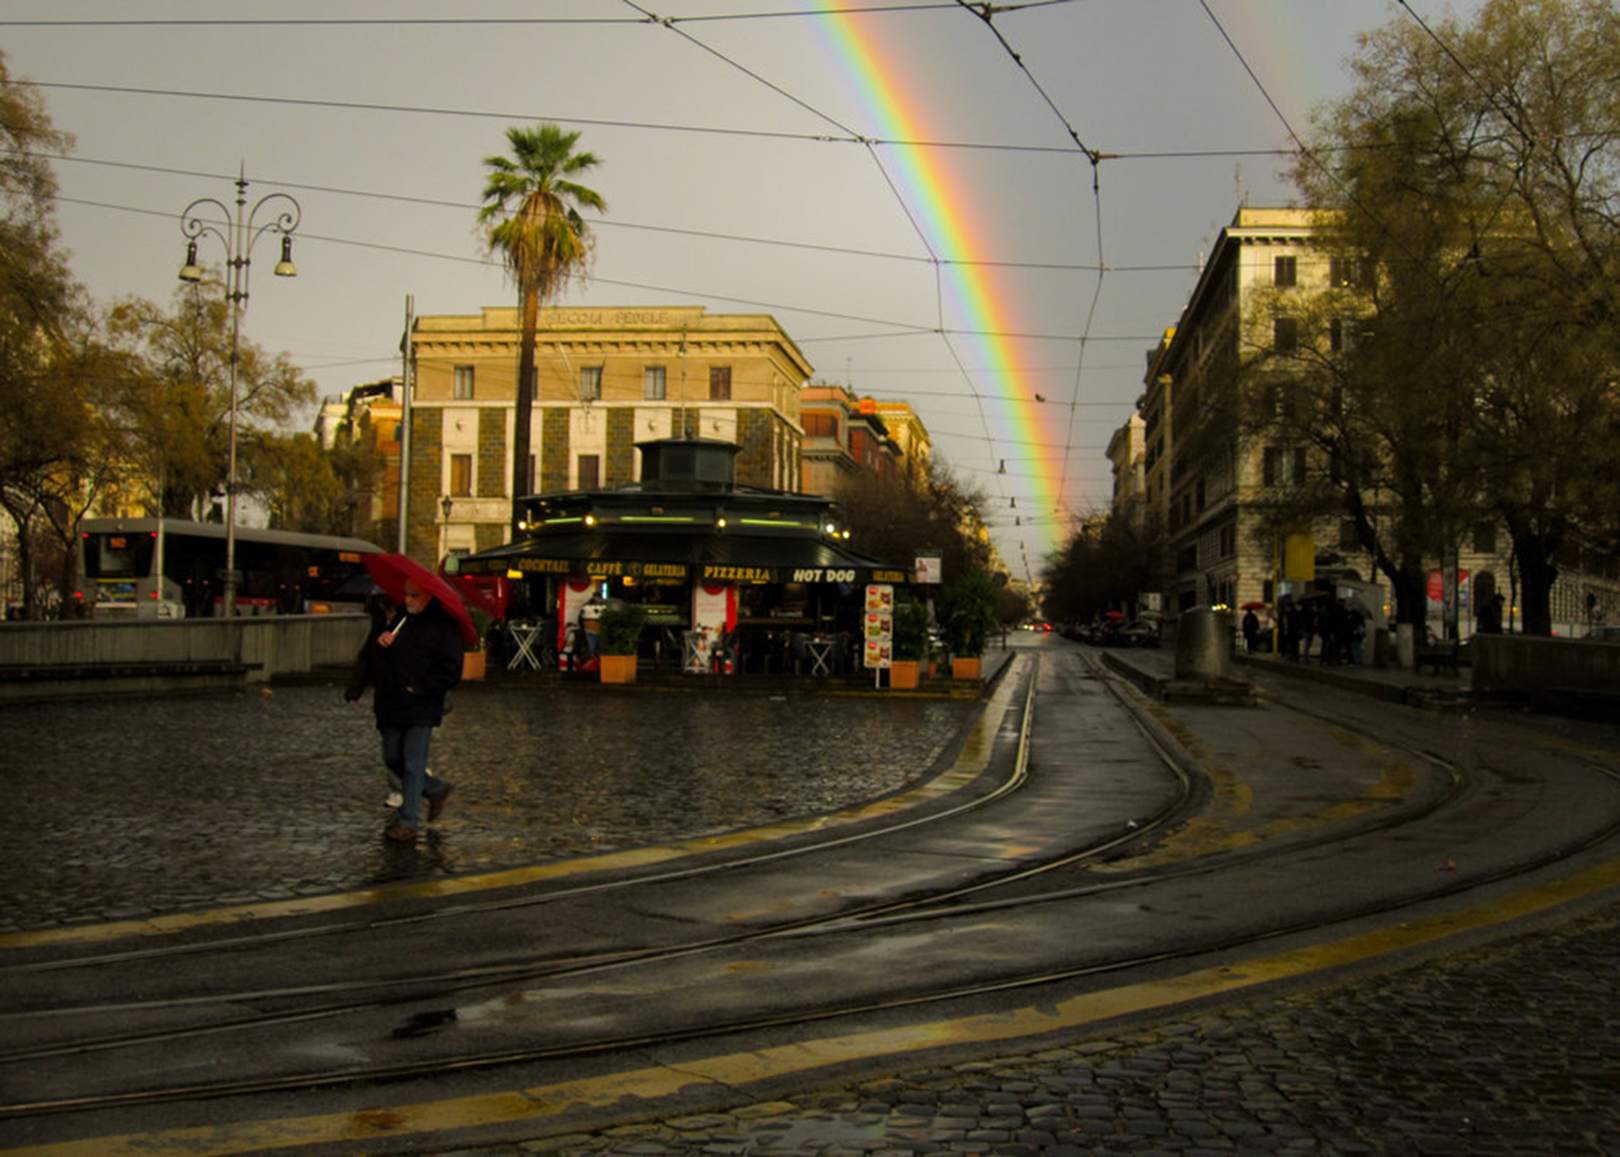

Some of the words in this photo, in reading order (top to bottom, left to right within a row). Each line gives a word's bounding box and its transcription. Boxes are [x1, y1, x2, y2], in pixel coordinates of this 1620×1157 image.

[518, 558, 570, 572] COCKTAIL
[643, 563, 686, 577] GELATERIA
[704, 565, 771, 581] PIZZERIA
[793, 568, 823, 583] HOT
[826, 568, 856, 583] DOG
